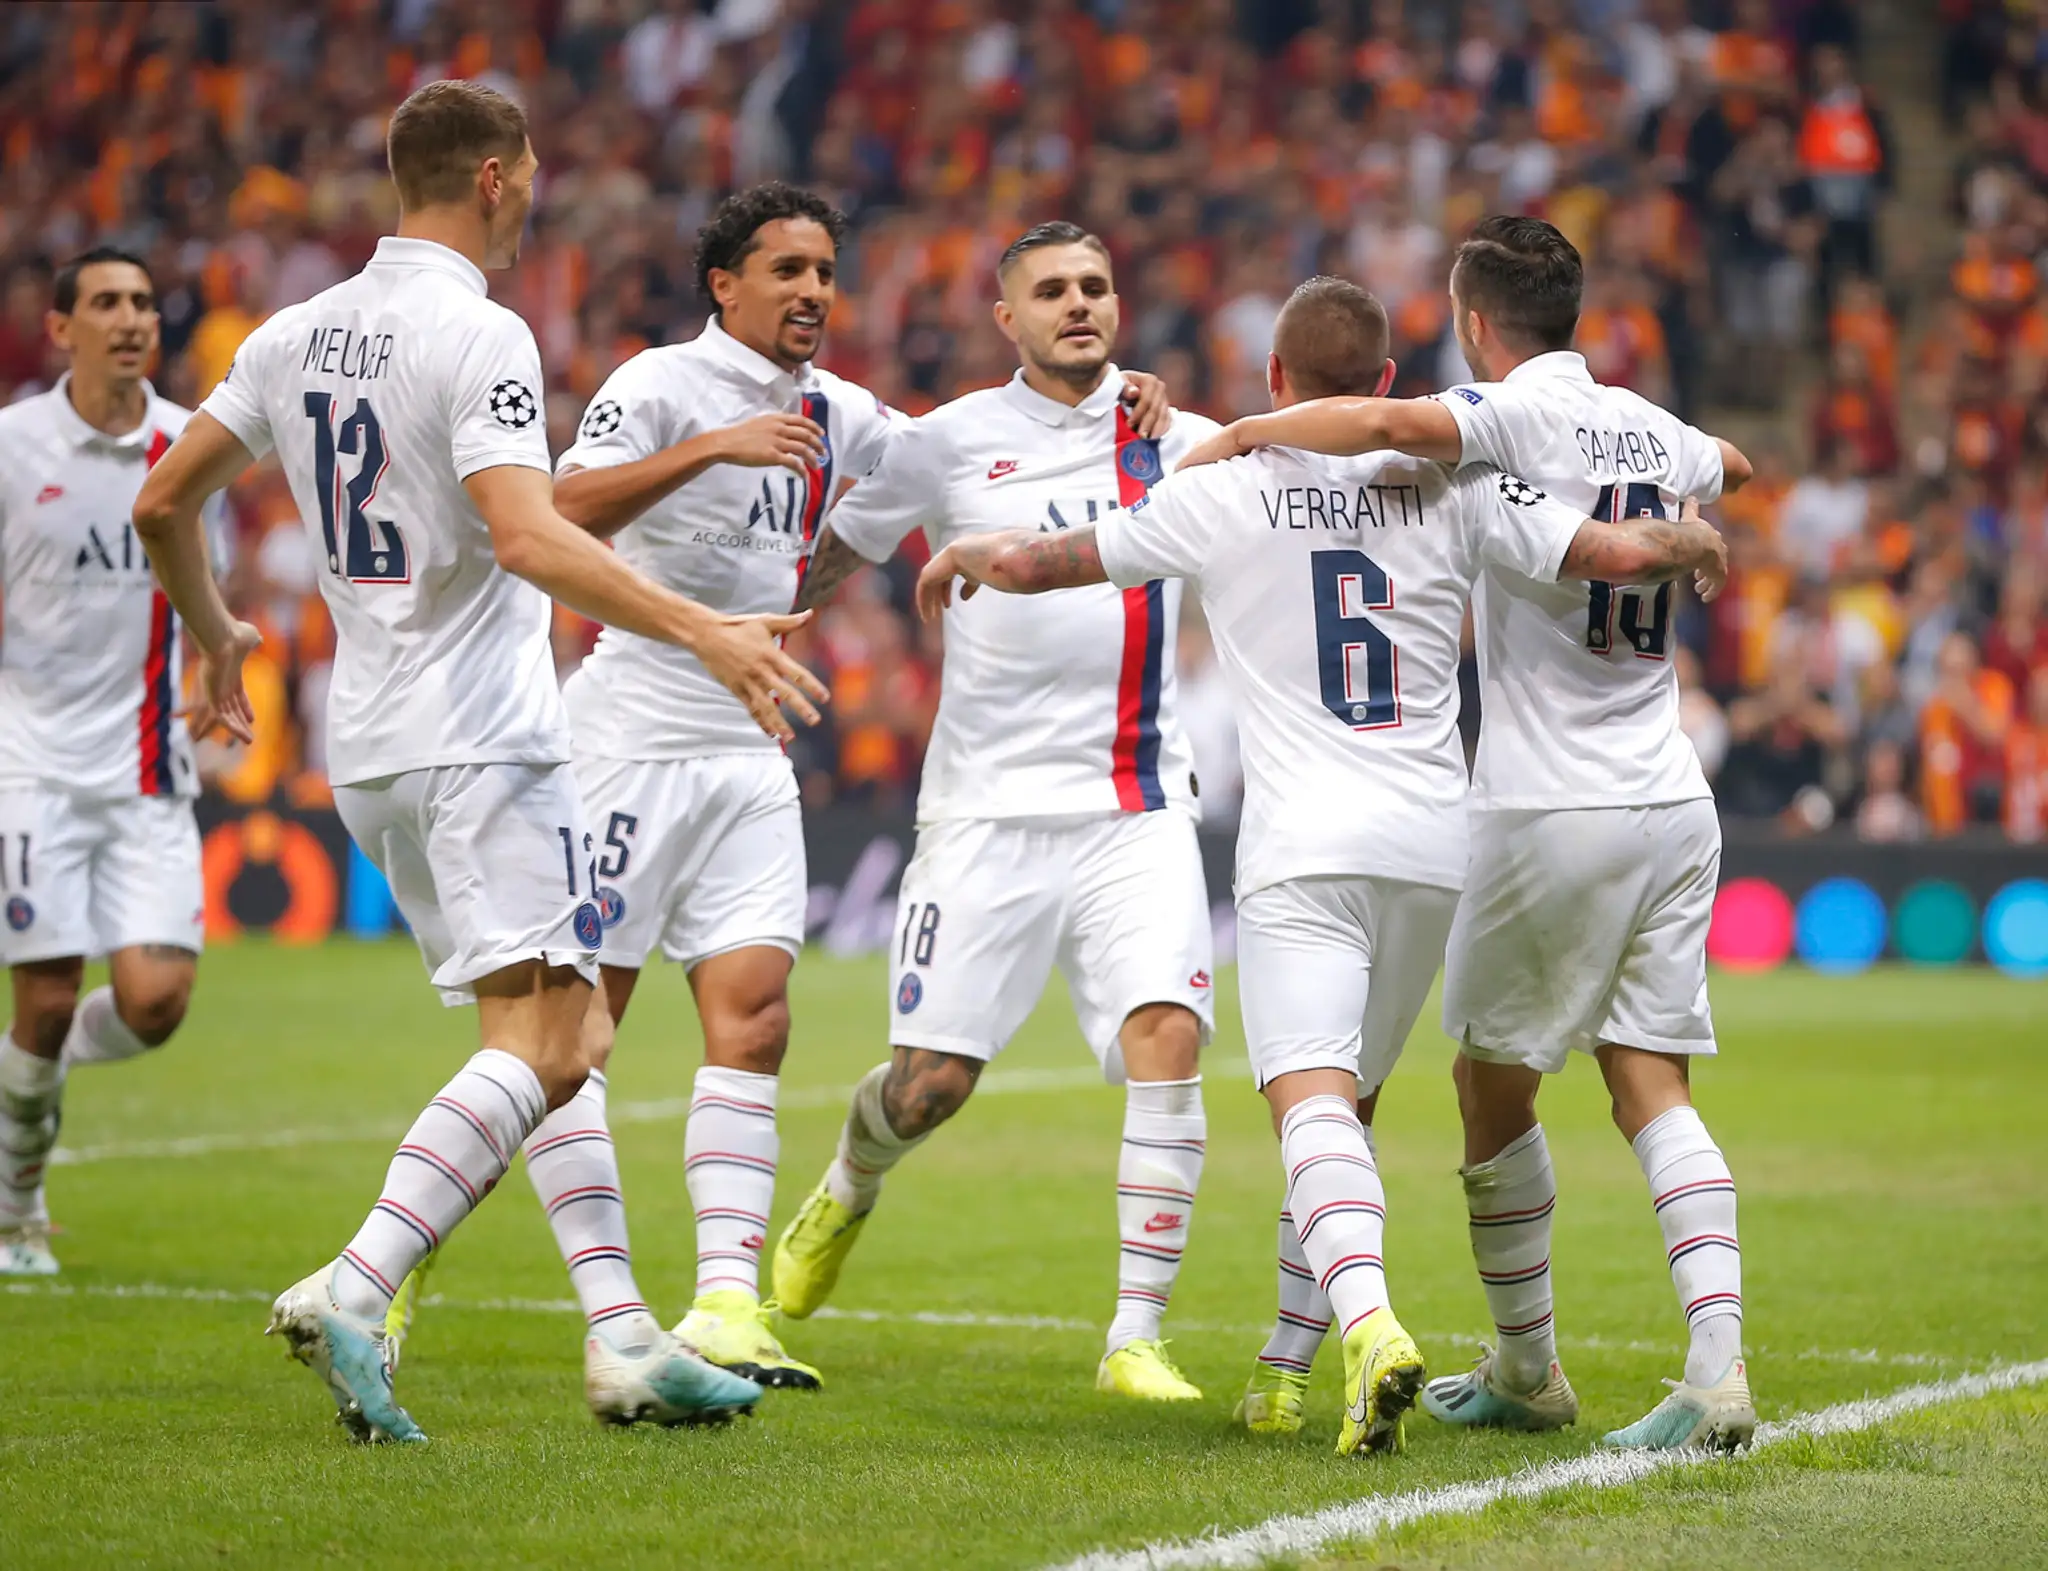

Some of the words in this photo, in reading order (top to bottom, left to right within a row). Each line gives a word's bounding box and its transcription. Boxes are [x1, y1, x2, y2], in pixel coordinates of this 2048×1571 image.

[302, 327, 394, 380] MEUNER
[303, 391, 411, 584] 12
[1260, 484, 1424, 530] VERRATTI
[692, 531, 751, 549] ACCOR
[1310, 549, 1402, 731] 6
[599, 811, 638, 880] 5
[900, 902, 941, 967] 18
